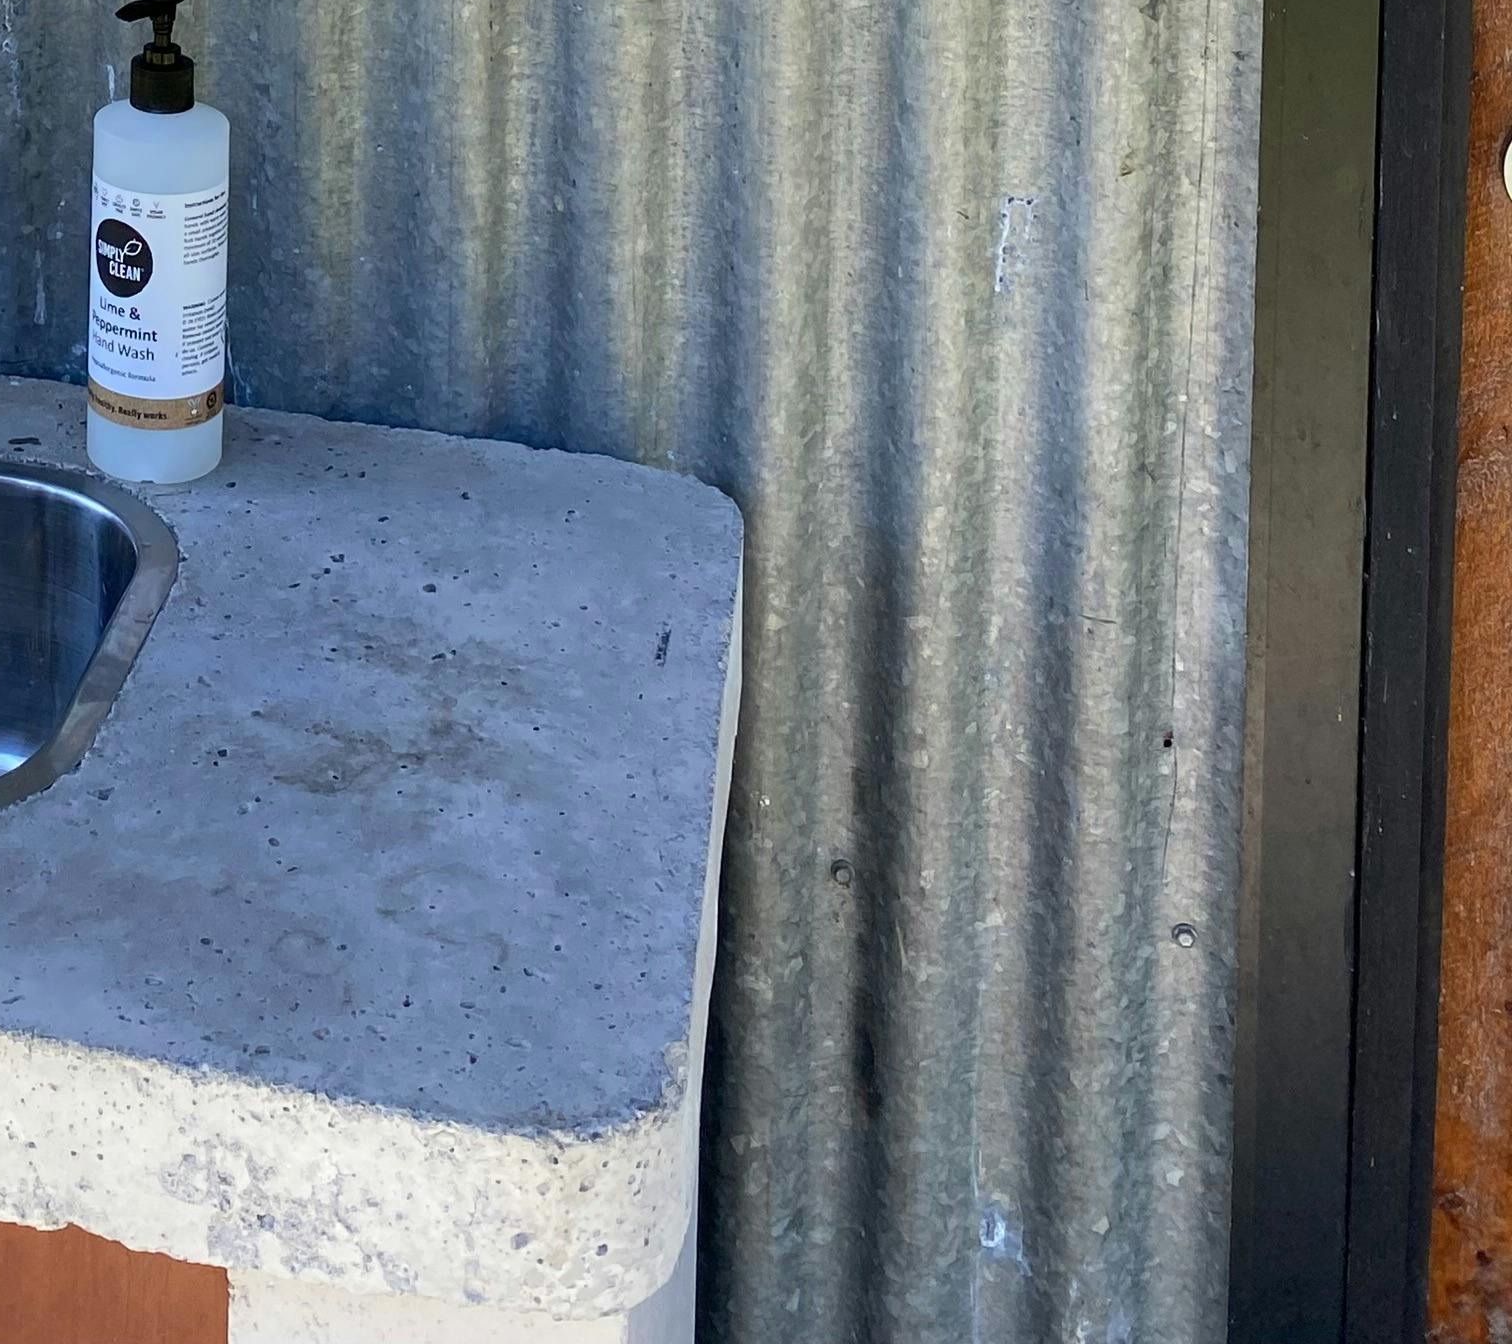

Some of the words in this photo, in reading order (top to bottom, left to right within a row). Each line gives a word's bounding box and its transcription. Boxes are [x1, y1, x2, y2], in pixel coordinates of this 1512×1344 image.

[98, 239, 125, 263] SIMPLY
[109, 260, 140, 282] CLEAN
[100, 296, 125, 317] Lime
[129, 307, 141, 320] &
[92, 309, 158, 342] Peppermint
[118, 343, 155, 361] Wash
